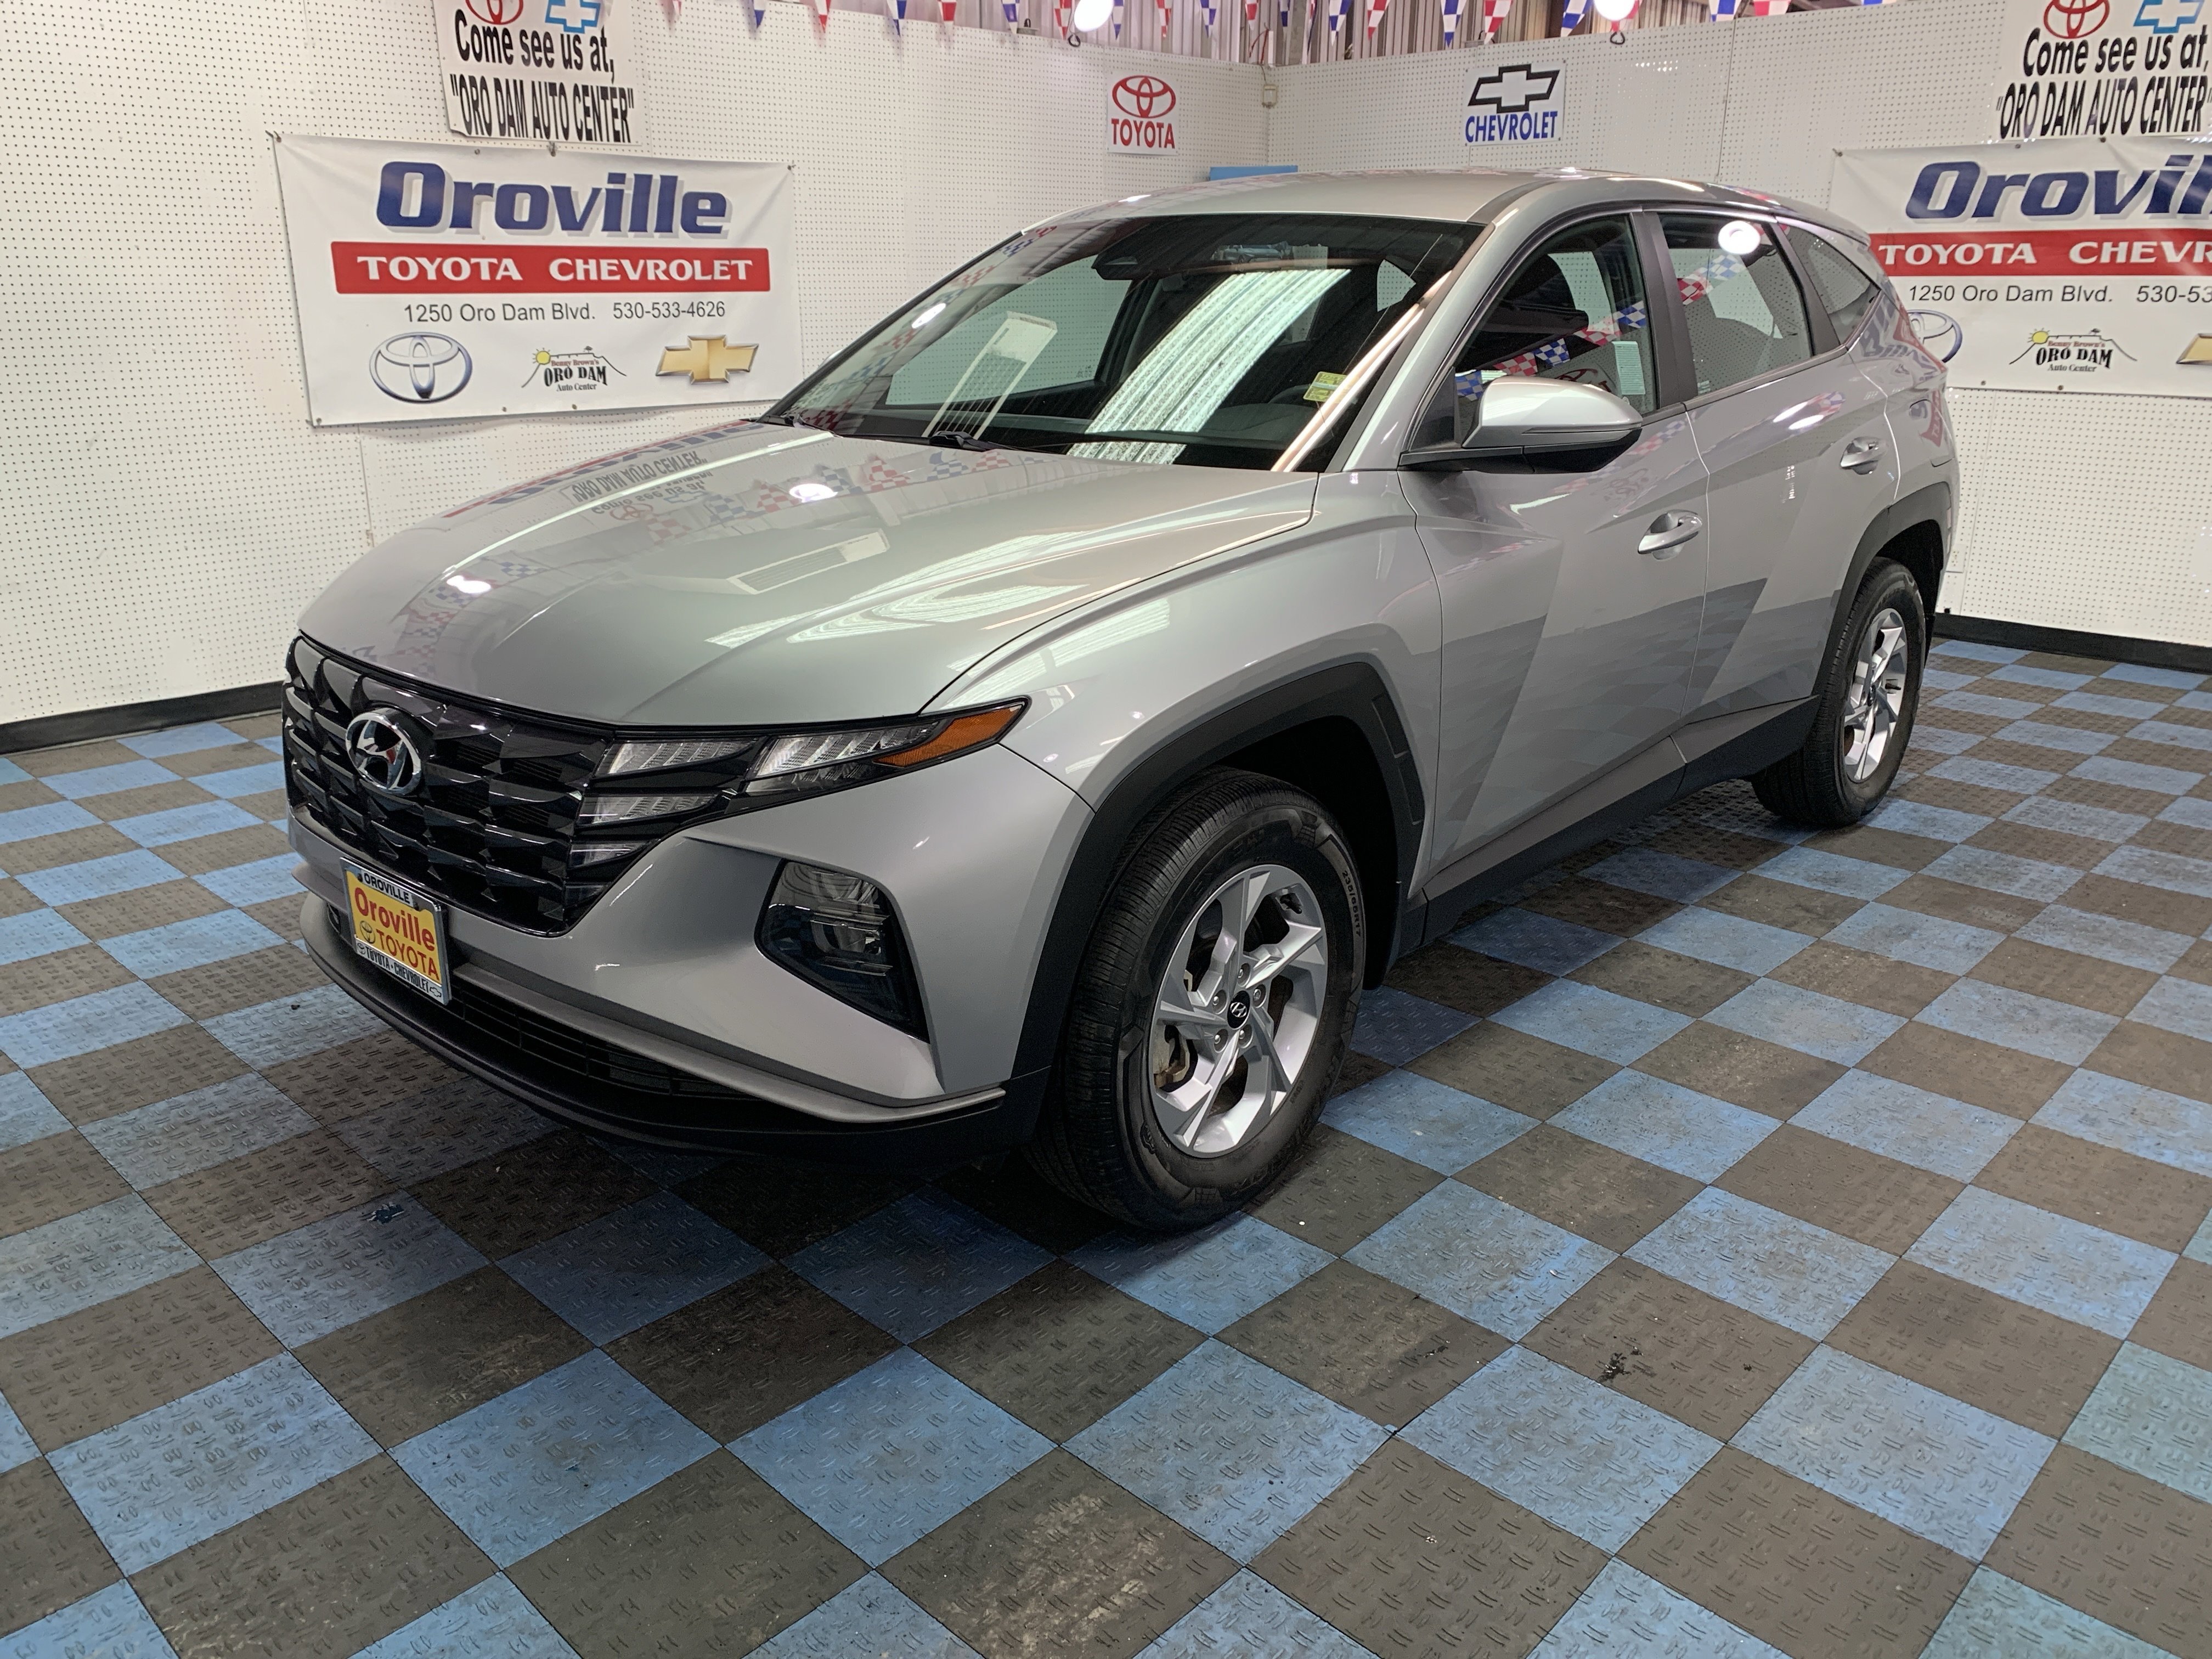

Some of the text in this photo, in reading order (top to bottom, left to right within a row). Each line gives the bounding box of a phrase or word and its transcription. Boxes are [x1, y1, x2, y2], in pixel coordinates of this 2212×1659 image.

[455, 9, 614, 84] Come see us at,
[2023, 25, 2209, 76] Come see us at,
[450, 74, 634, 143] "ORO DAM AUTO CENTER"
[1465, 111, 1558, 143] CHEVROLET
[1996, 81, 2040, 139] "ORO
[2040, 80, 2086, 136] DAM
[2086, 76, 2138, 135] AUTO
[1111, 119, 1175, 149] TOYOTA
[376, 161, 729, 236] Oroville
[1905, 155, 2212, 219] Orovil
[357, 256, 752, 281] TOYOTA CHEVROLET
[1878, 243, 2038, 265] TOYOTA
[405, 301, 725, 322] 1250 Oro Dam Blvd. 530-533-4626
[1909, 285, 1955, 302] 1250
[1963, 285, 1998, 302] Oro
[2006, 285, 2053, 302] Dam
[2061, 285, 2112, 302] Blvd.
[544, 366, 607, 386] ORO DAM
[2036, 347, 2113, 369] ORO DAM
[364, 872, 410, 904] OROVILLE
[354, 887, 435, 951] Oroville
[365, 946, 428, 994] TOYOTA CHEVROLET
[376, 929, 439, 981] TOYOTA
